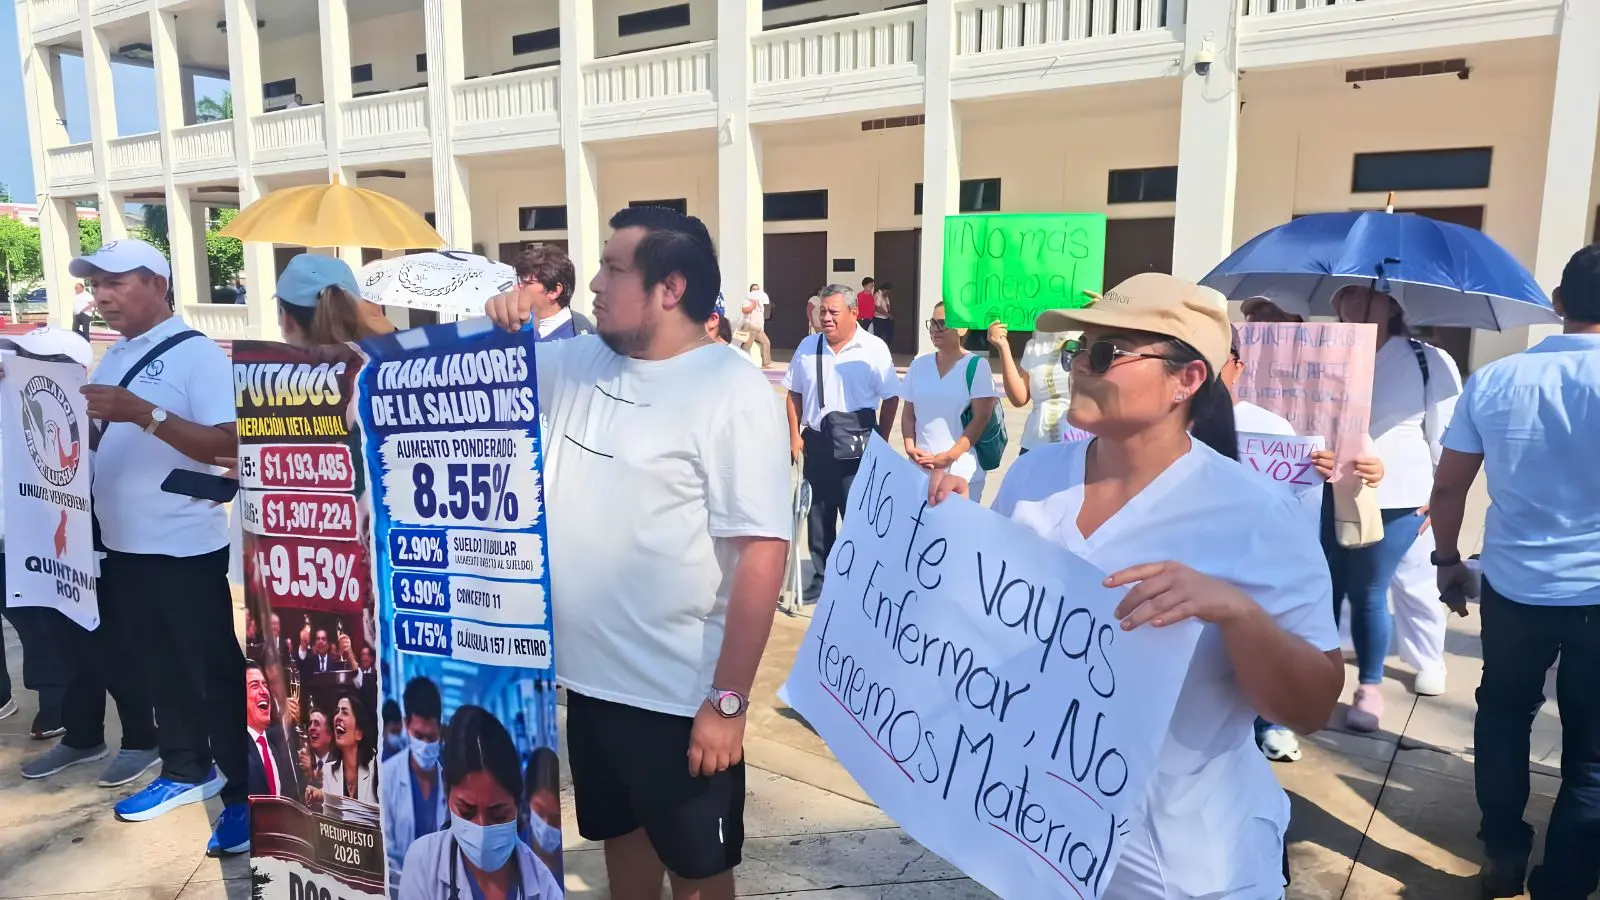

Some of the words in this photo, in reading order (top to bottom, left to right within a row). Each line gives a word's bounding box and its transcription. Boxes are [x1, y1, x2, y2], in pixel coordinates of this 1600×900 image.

[377, 345, 528, 390] TRABAJADORES
[233, 362, 346, 407] PUTADOS
[371, 395, 397, 426] DE
[396, 394, 425, 425] LA
[423, 390, 491, 425] SALUD
[492, 387, 535, 422] IMSS
[286, 416, 312, 436] NETA
[314, 415, 347, 436] ANUAL
[397, 440, 449, 458] AUMENTO
[454, 438, 517, 458] PONDERADO:
[264, 452, 348, 484] $1,193,485
[412, 462, 519, 522] 8.55%
[267, 500, 352, 533] $1,307,224
[397, 535, 443, 562] 2.90%
[905, 500, 948, 590] te
[56, 579, 80, 602] ROO
[400, 578, 444, 606] 3.90%
[492, 594, 501, 610] 11
[402, 620, 447, 649] 1.75%
[490, 637, 505, 655] 157
[514, 639, 547, 657] RETIRO
[836, 540, 855, 580] a
[1050, 698, 1129, 796] No
[333, 844, 360, 865] 2026
